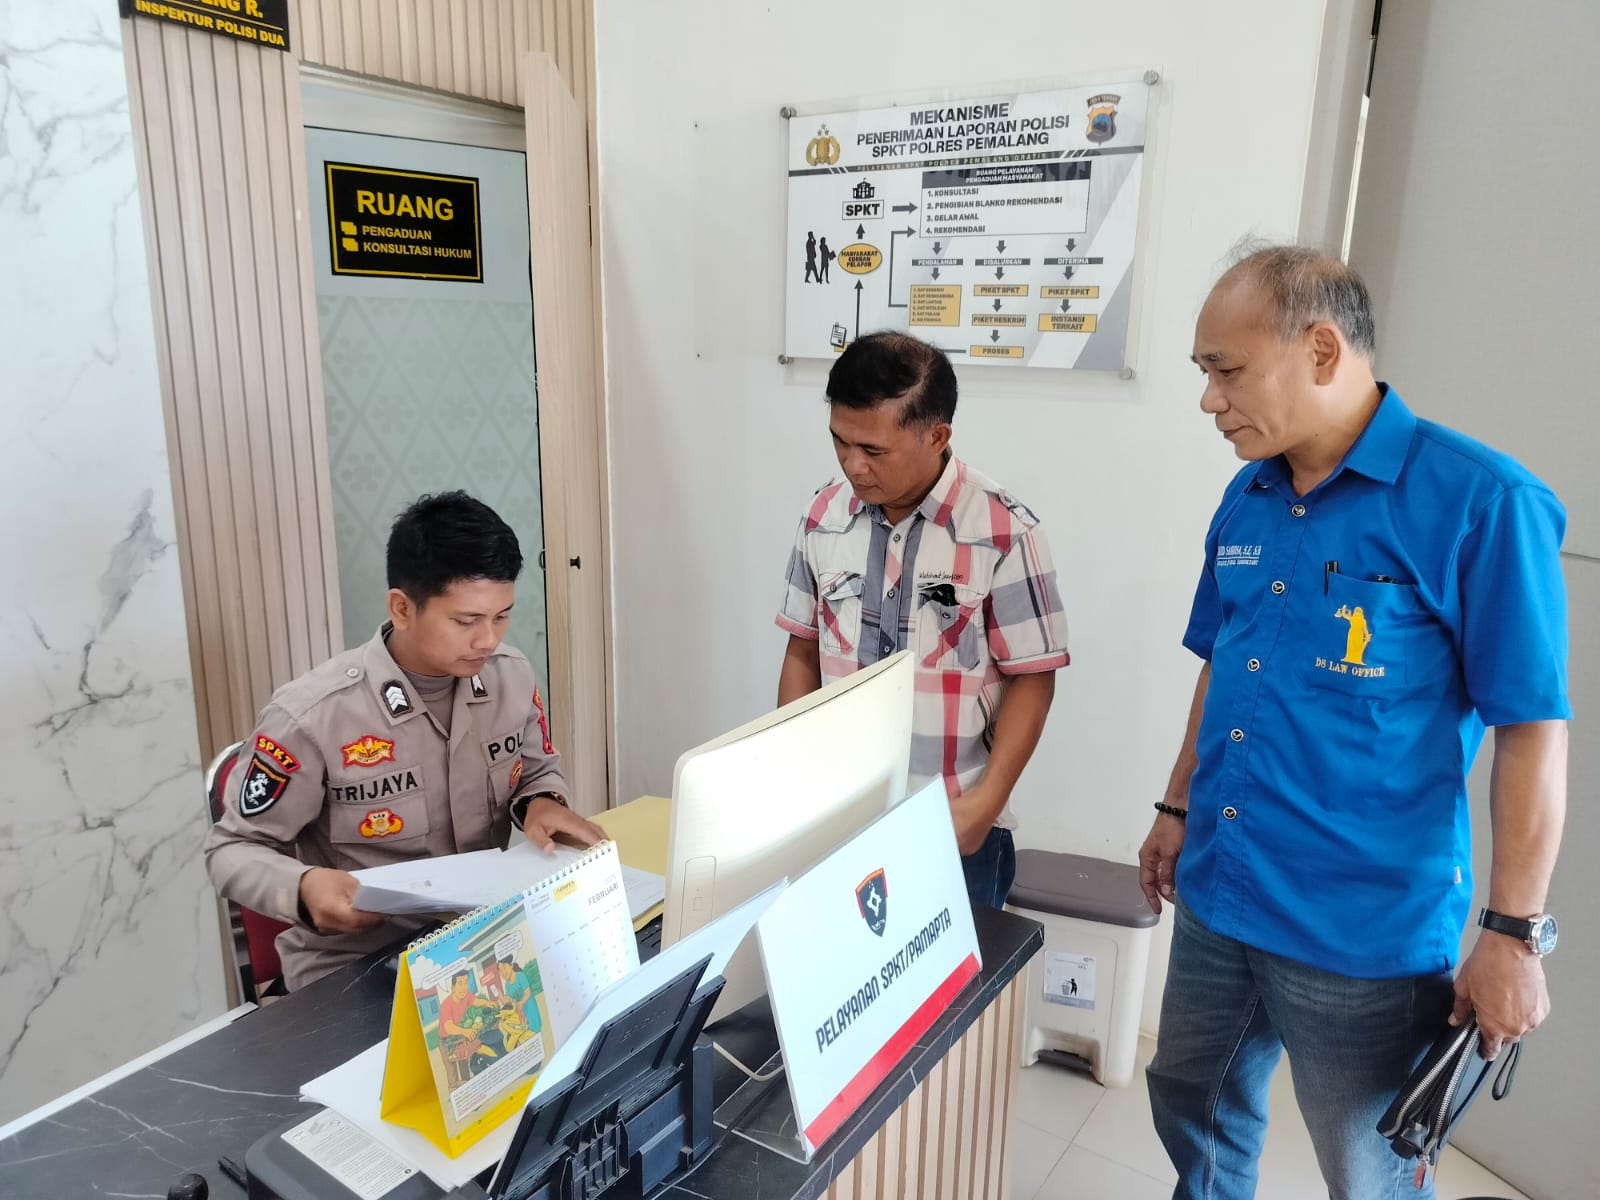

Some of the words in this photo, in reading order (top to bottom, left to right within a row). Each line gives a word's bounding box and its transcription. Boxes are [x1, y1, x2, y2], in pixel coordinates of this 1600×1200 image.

[135, 0, 214, 28] INSPEKTUR
[216, 19, 257, 39] POLISI
[260, 30, 285, 46] DUA
[910, 103, 1009, 126] MEKANISME
[857, 126, 944, 145] PENERIMAAN
[947, 120, 1017, 138] LAPORAN
[1020, 115, 1070, 132] POLISI
[872, 143, 907, 158] SPKT
[909, 139, 963, 154] POLRES
[966, 132, 1049, 150] PEMALANG
[997, 167, 1034, 175] PELAYANAN
[934, 188, 979, 197] KONSULTASI
[934, 200, 975, 209] PENGISIAN
[975, 199, 1005, 208] BLANKO
[1006, 196, 1063, 206] REKOMENDASI
[357, 190, 454, 221] RUANG
[845, 203, 881, 217] SPKT
[362, 225, 432, 240] PENGADUAN
[926, 227, 933, 235] 4.
[934, 225, 986, 234] REKOMENDASI
[363, 242, 432, 256] KONSULTASI
[434, 247, 472, 259] HUKUM
[1048, 288, 1070, 296] PIKET
[1070, 288, 1090, 296] SPKT
[1051, 315, 1086, 323] INSTANSI
[1315, 656, 1327, 669] DS
[1329, 660, 1348, 674] LAW
[1351, 666, 1385, 678] OFFICE
[258, 737, 294, 766] SPKT
[488, 732, 523, 761] POL
[331, 771, 418, 801] TRIJAYA
[815, 975, 880, 1054] PELAYANAN
[880, 907, 952, 990] SPKT/PAMAPTA
